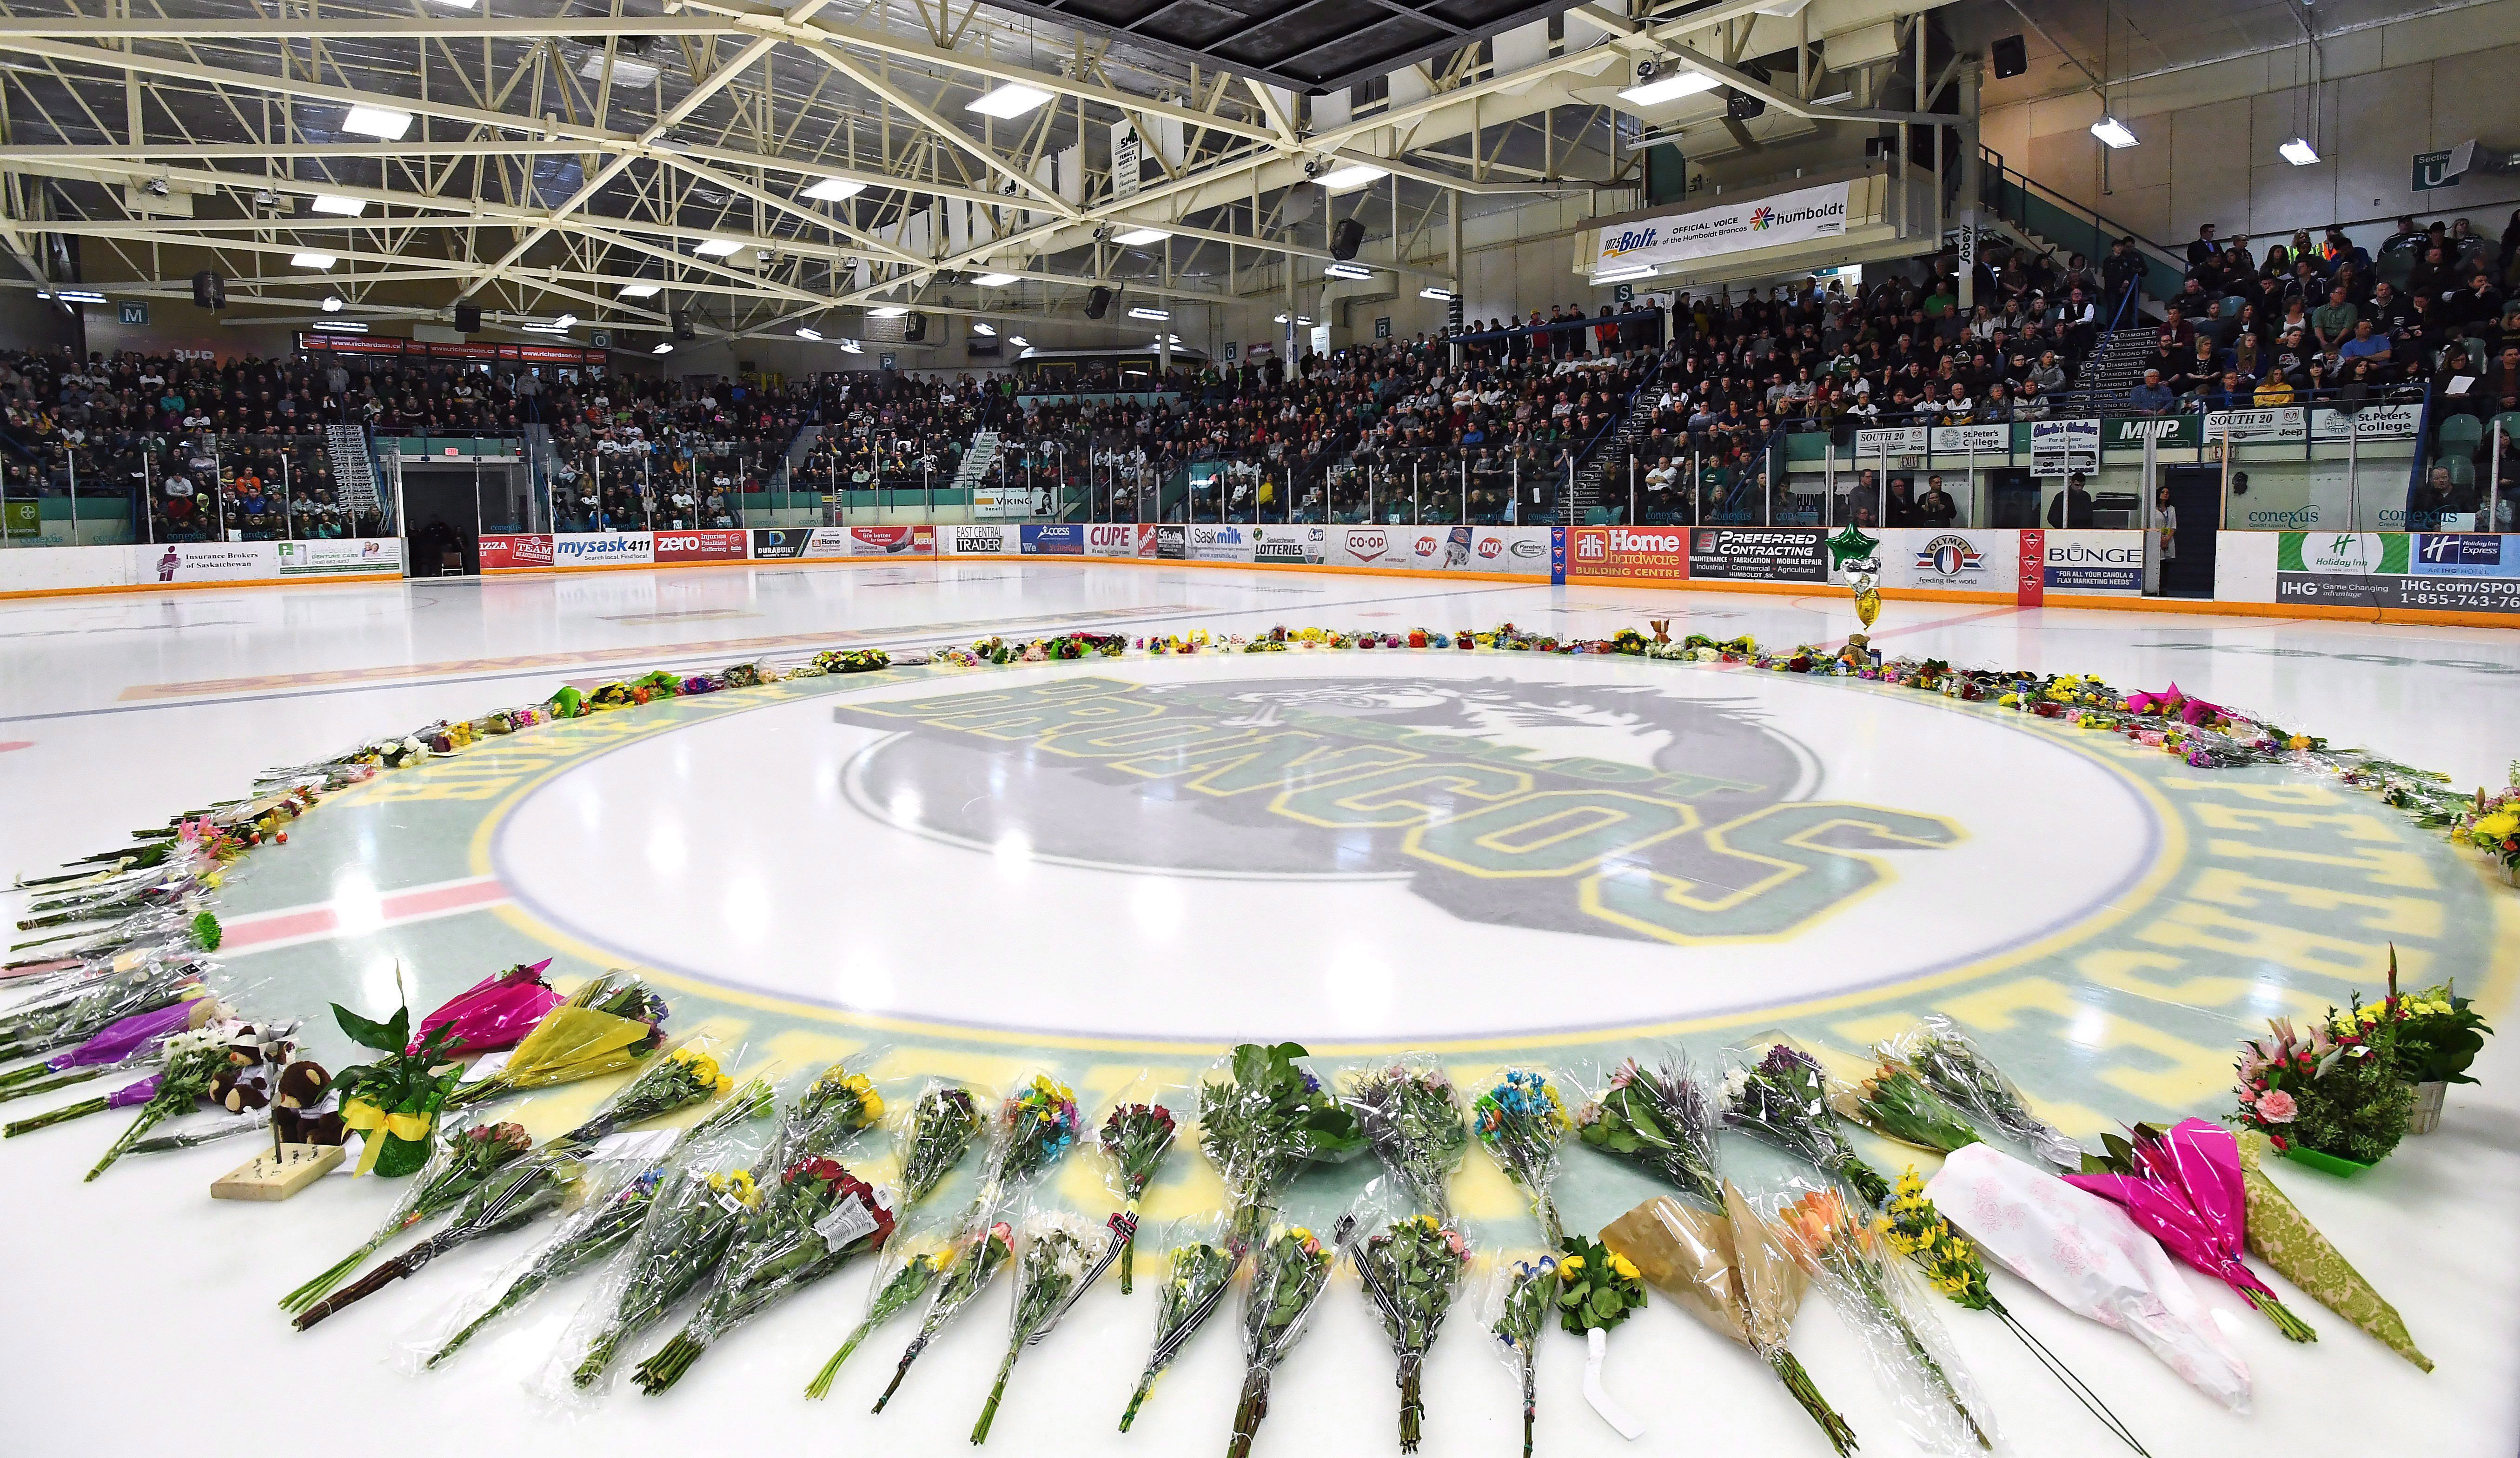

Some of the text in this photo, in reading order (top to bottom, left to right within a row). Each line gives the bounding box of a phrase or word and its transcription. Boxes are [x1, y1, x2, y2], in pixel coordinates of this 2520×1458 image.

[1120, 150, 1134, 160] FEMALE
[2419, 154, 2450, 163] Sectio
[1118, 156, 1132, 167] MIDGET
[2425, 163, 2446, 186] U
[1777, 202, 1844, 225] humboldt
[1672, 217, 1738, 234] OFFICIAL VOICE
[1618, 228, 1657, 252] Bolt
[1683, 231, 1718, 242] Humboldt
[1718, 226, 1747, 236] Broncos
[1959, 224, 1972, 264] Sobeys
[1620, 285, 1629, 300] S
[125, 309, 142, 322] M
[1379, 325, 1386, 336] R
[331, 340, 401, 349] www.richardson.ca
[596, 336, 606, 347] O
[431, 345, 495, 354] www.richardson.ca
[522, 351, 581, 359] www.richardson.ca
[1227, 348, 1234, 358] Q
[884, 358, 892, 368] P
[2210, 413, 2273, 425] SOUTH 20
[2034, 422, 2098, 437] Charlie's Charters
[2358, 422, 2411, 432] College
[1860, 432, 1904, 442] SOUTH 20
[1902, 457, 1916, 467] EXIT
[2249, 508, 2319, 525] conexus
[2379, 507, 2459, 525] conexus
[167, 531, 206, 540] conexus
[957, 526, 1002, 537] EAST CENTRAL
[1090, 526, 1130, 546] CUPE
[1139, 525, 1156, 550] BRICK
[1719, 531, 1817, 544] PREFERRED
[558, 536, 651, 557] mysask411
[657, 537, 699, 551] zero
[958, 539, 1000, 551] TRADER
[1418, 541, 1435, 552] DQ
[1609, 530, 1680, 552] Home
[1930, 537, 1968, 552] OLYMEL
[517, 543, 552, 555] TEAM
[1023, 543, 1037, 552] We
[1256, 544, 1303, 555] LOTTERIES
[1482, 542, 1499, 555] DQ
[1720, 543, 1814, 556] CONTRACTING
[2462, 546, 2498, 555] Express
[516, 551, 551, 561] HEADQUARTERS
[1609, 551, 1679, 566] hardware
[2049, 548, 2142, 563] BUNGE
[2316, 558, 2351, 567] Holiday
[1576, 567, 1680, 577] BUILDING CENTRE
[2282, 582, 2318, 595] IHG
[2348, 583, 2388, 593] Changing
[2323, 590, 2362, 598] advantage
[836, 676, 1972, 947] BRONCOS
